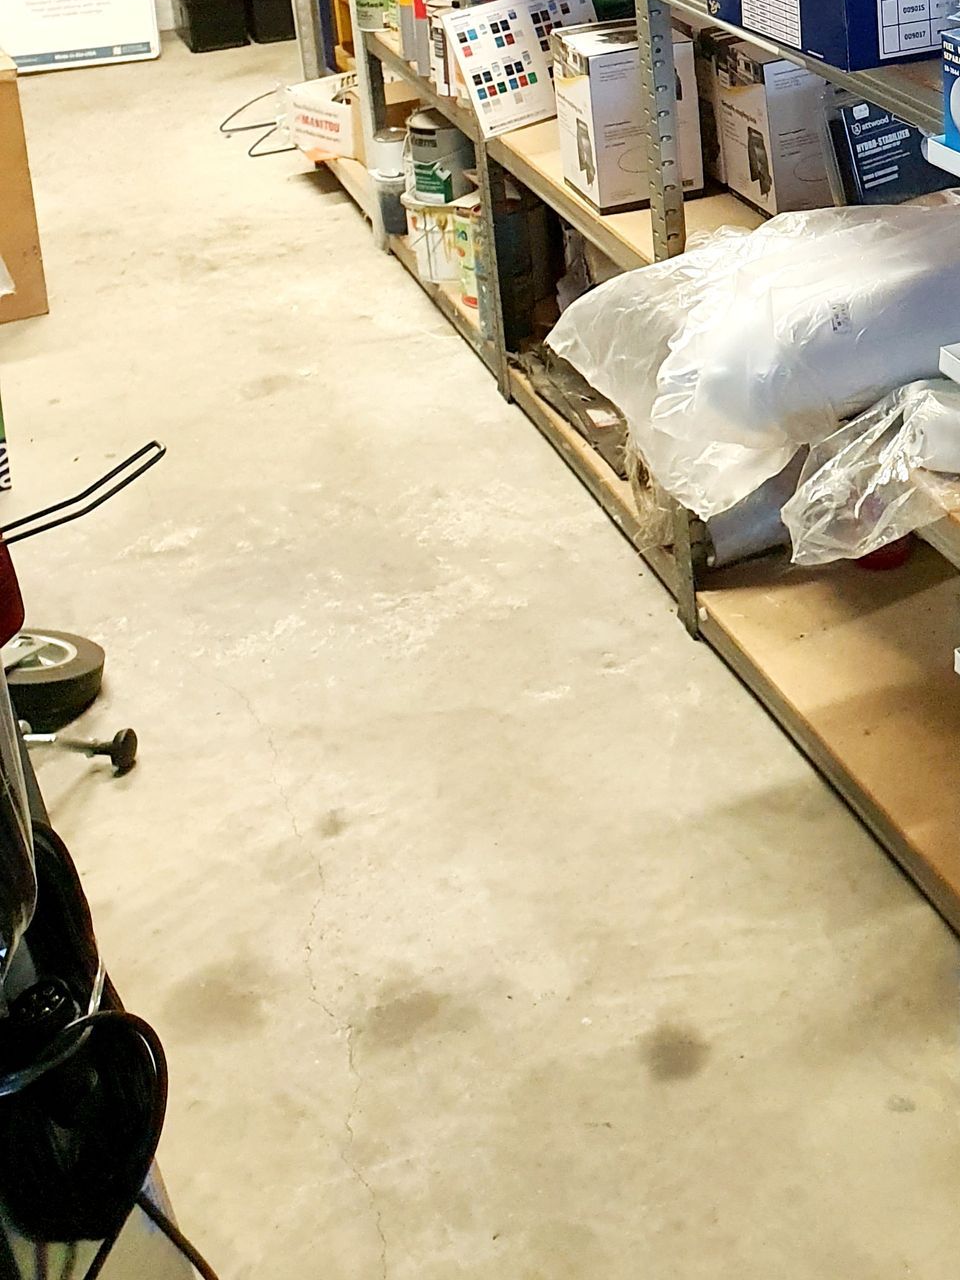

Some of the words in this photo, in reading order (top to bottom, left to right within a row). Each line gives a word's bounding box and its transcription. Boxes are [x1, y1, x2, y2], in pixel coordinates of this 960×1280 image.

[904, 30, 926, 41] 009017
[943, 40, 955, 53] FUEL
[861, 114, 890, 131] attwood
